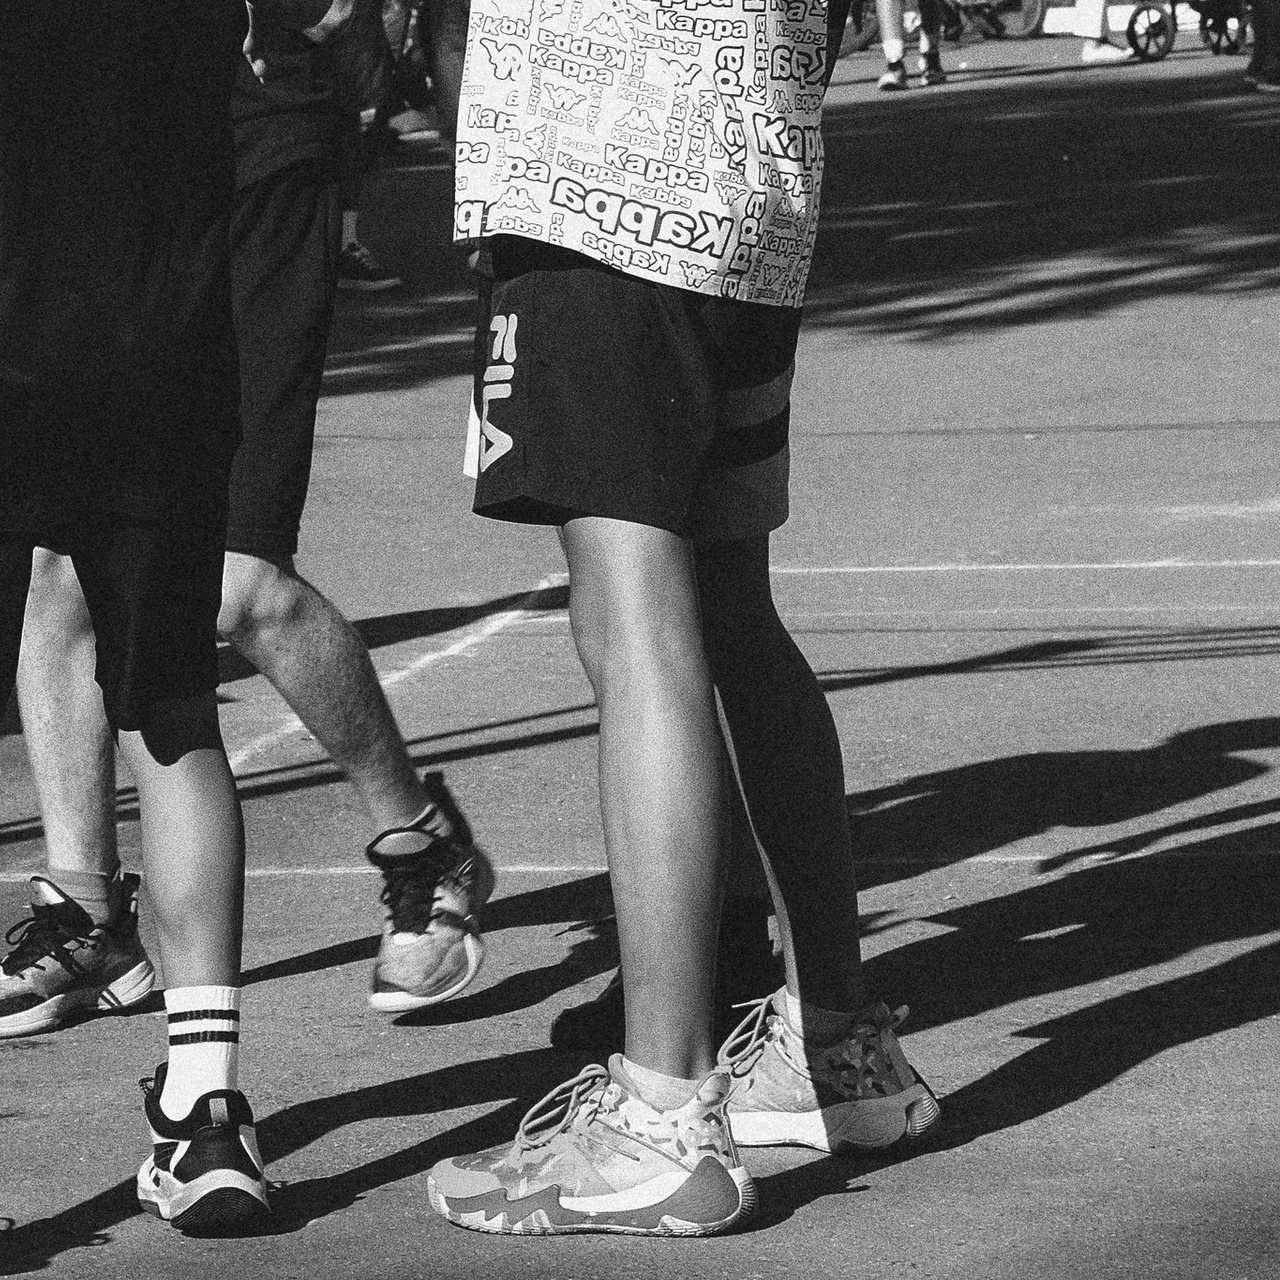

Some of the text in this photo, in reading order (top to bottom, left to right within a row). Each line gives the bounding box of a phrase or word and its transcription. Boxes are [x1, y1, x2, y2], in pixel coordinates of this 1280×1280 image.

[656, 9, 748, 40] Kappa
[529, 44, 613, 86] Kappa
[538, 27, 626, 69] Kappa
[746, 14, 768, 105] Kappa
[617, 87, 666, 110] Kappa
[620, 73, 667, 97] Kappa
[562, 136, 600, 154] Kappa
[611, 128, 660, 150] Kappa
[662, 90, 688, 162] Kappa
[557, 151, 625, 186] Kappa
[604, 143, 709, 193] Kappa
[480, 313, 518, 473] FILA
